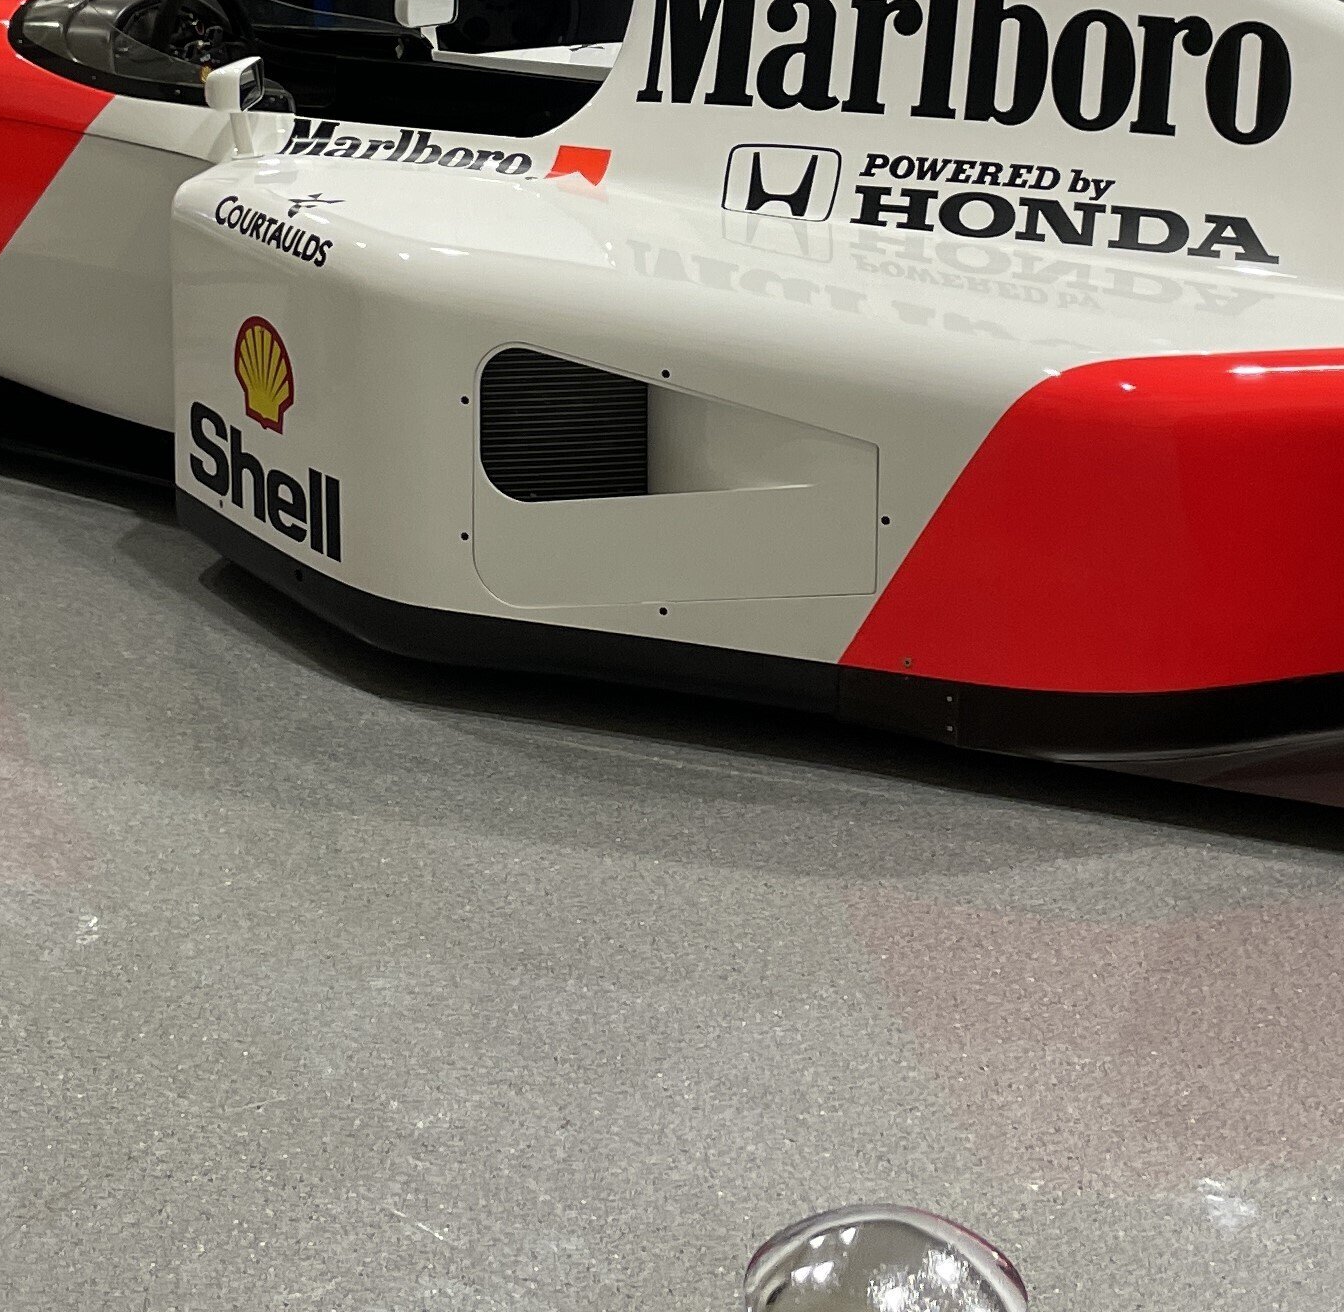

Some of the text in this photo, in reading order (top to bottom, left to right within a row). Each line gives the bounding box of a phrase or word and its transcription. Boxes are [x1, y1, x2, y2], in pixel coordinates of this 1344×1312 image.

[278, 118, 533, 176] Marlboro
[859, 153, 1115, 202] POWERED by
[215, 194, 334, 268] COURTAULDS
[849, 184, 1279, 264] HONDA
[190, 400, 343, 563] Shell
